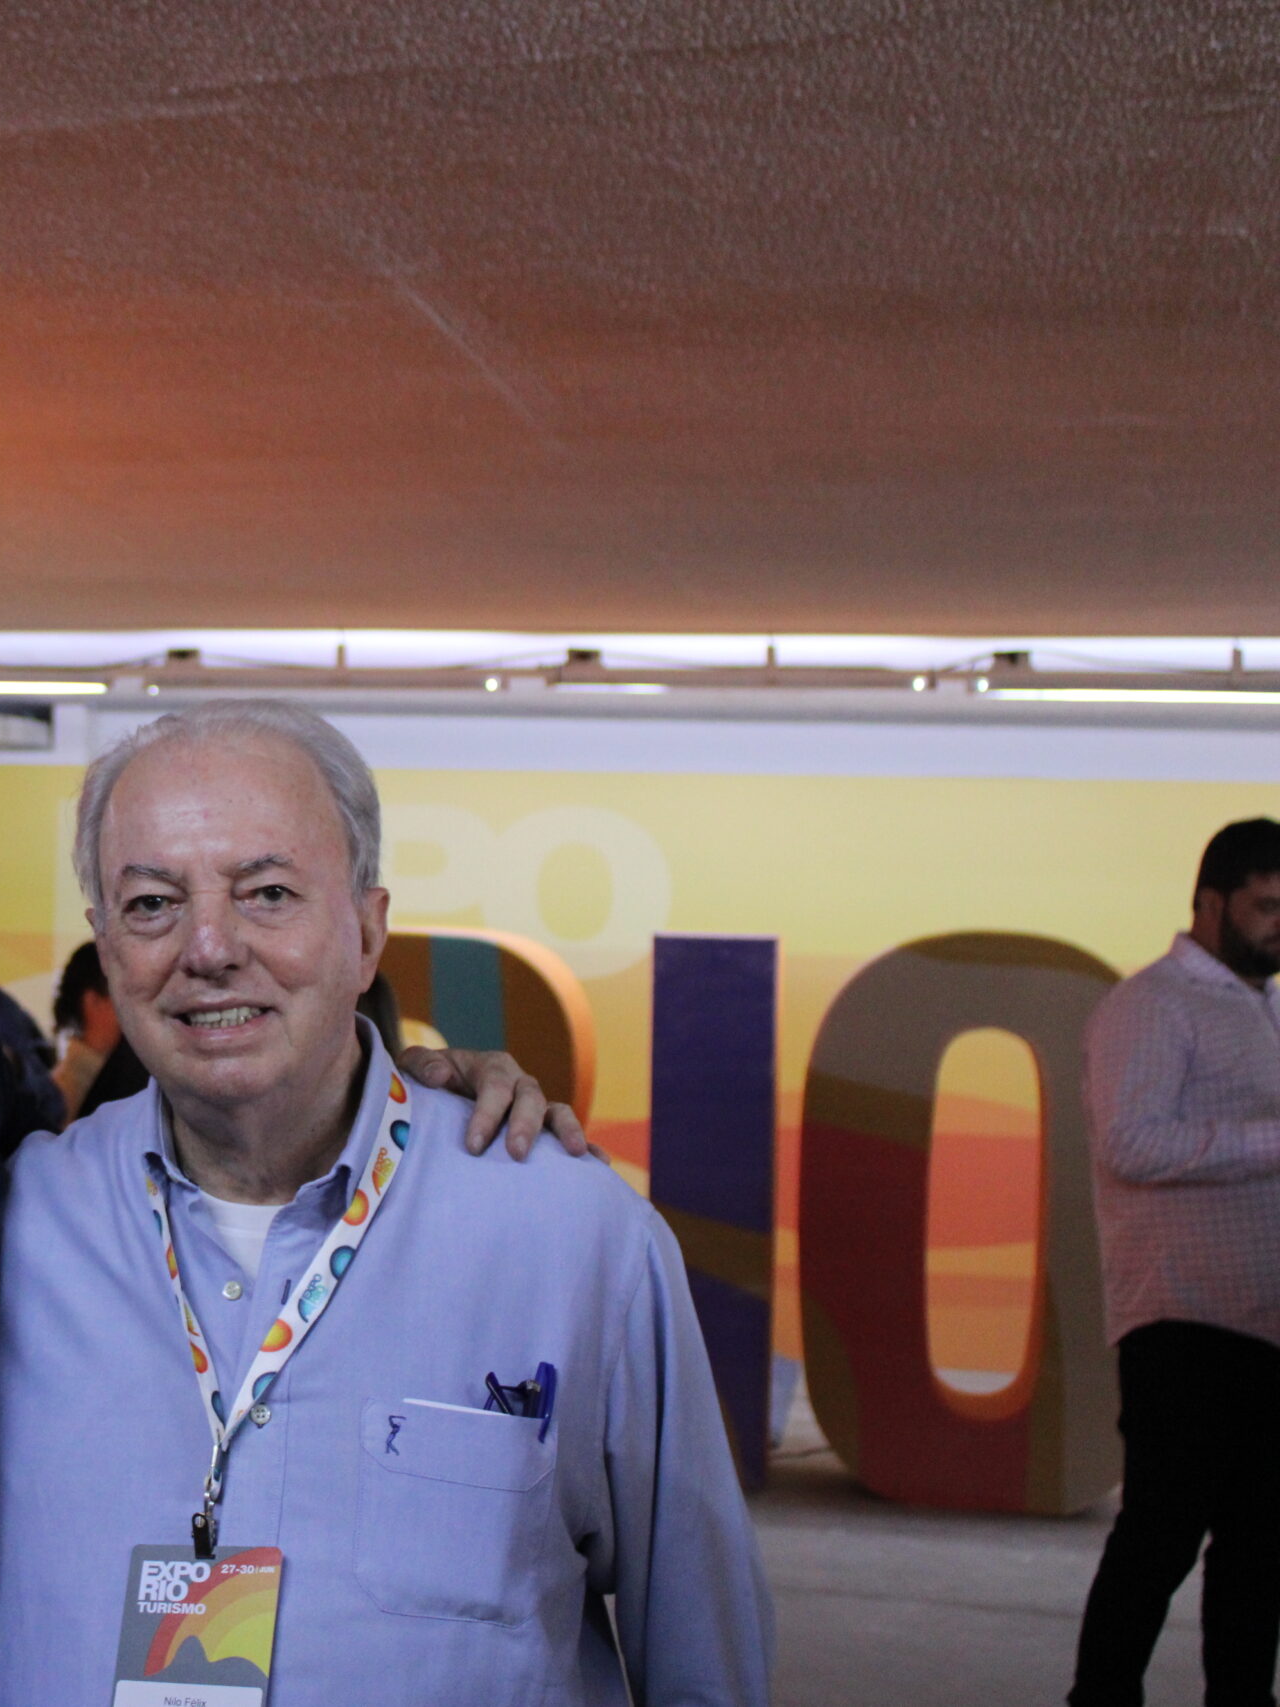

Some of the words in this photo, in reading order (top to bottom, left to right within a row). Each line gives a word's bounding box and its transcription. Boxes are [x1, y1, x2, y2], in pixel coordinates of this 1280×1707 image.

[142, 1560, 211, 1582] EXPO
[138, 1579, 189, 1602] RIO
[138, 1602, 207, 1615] TURISMO
[163, 1696, 182, 1706] Nilo
